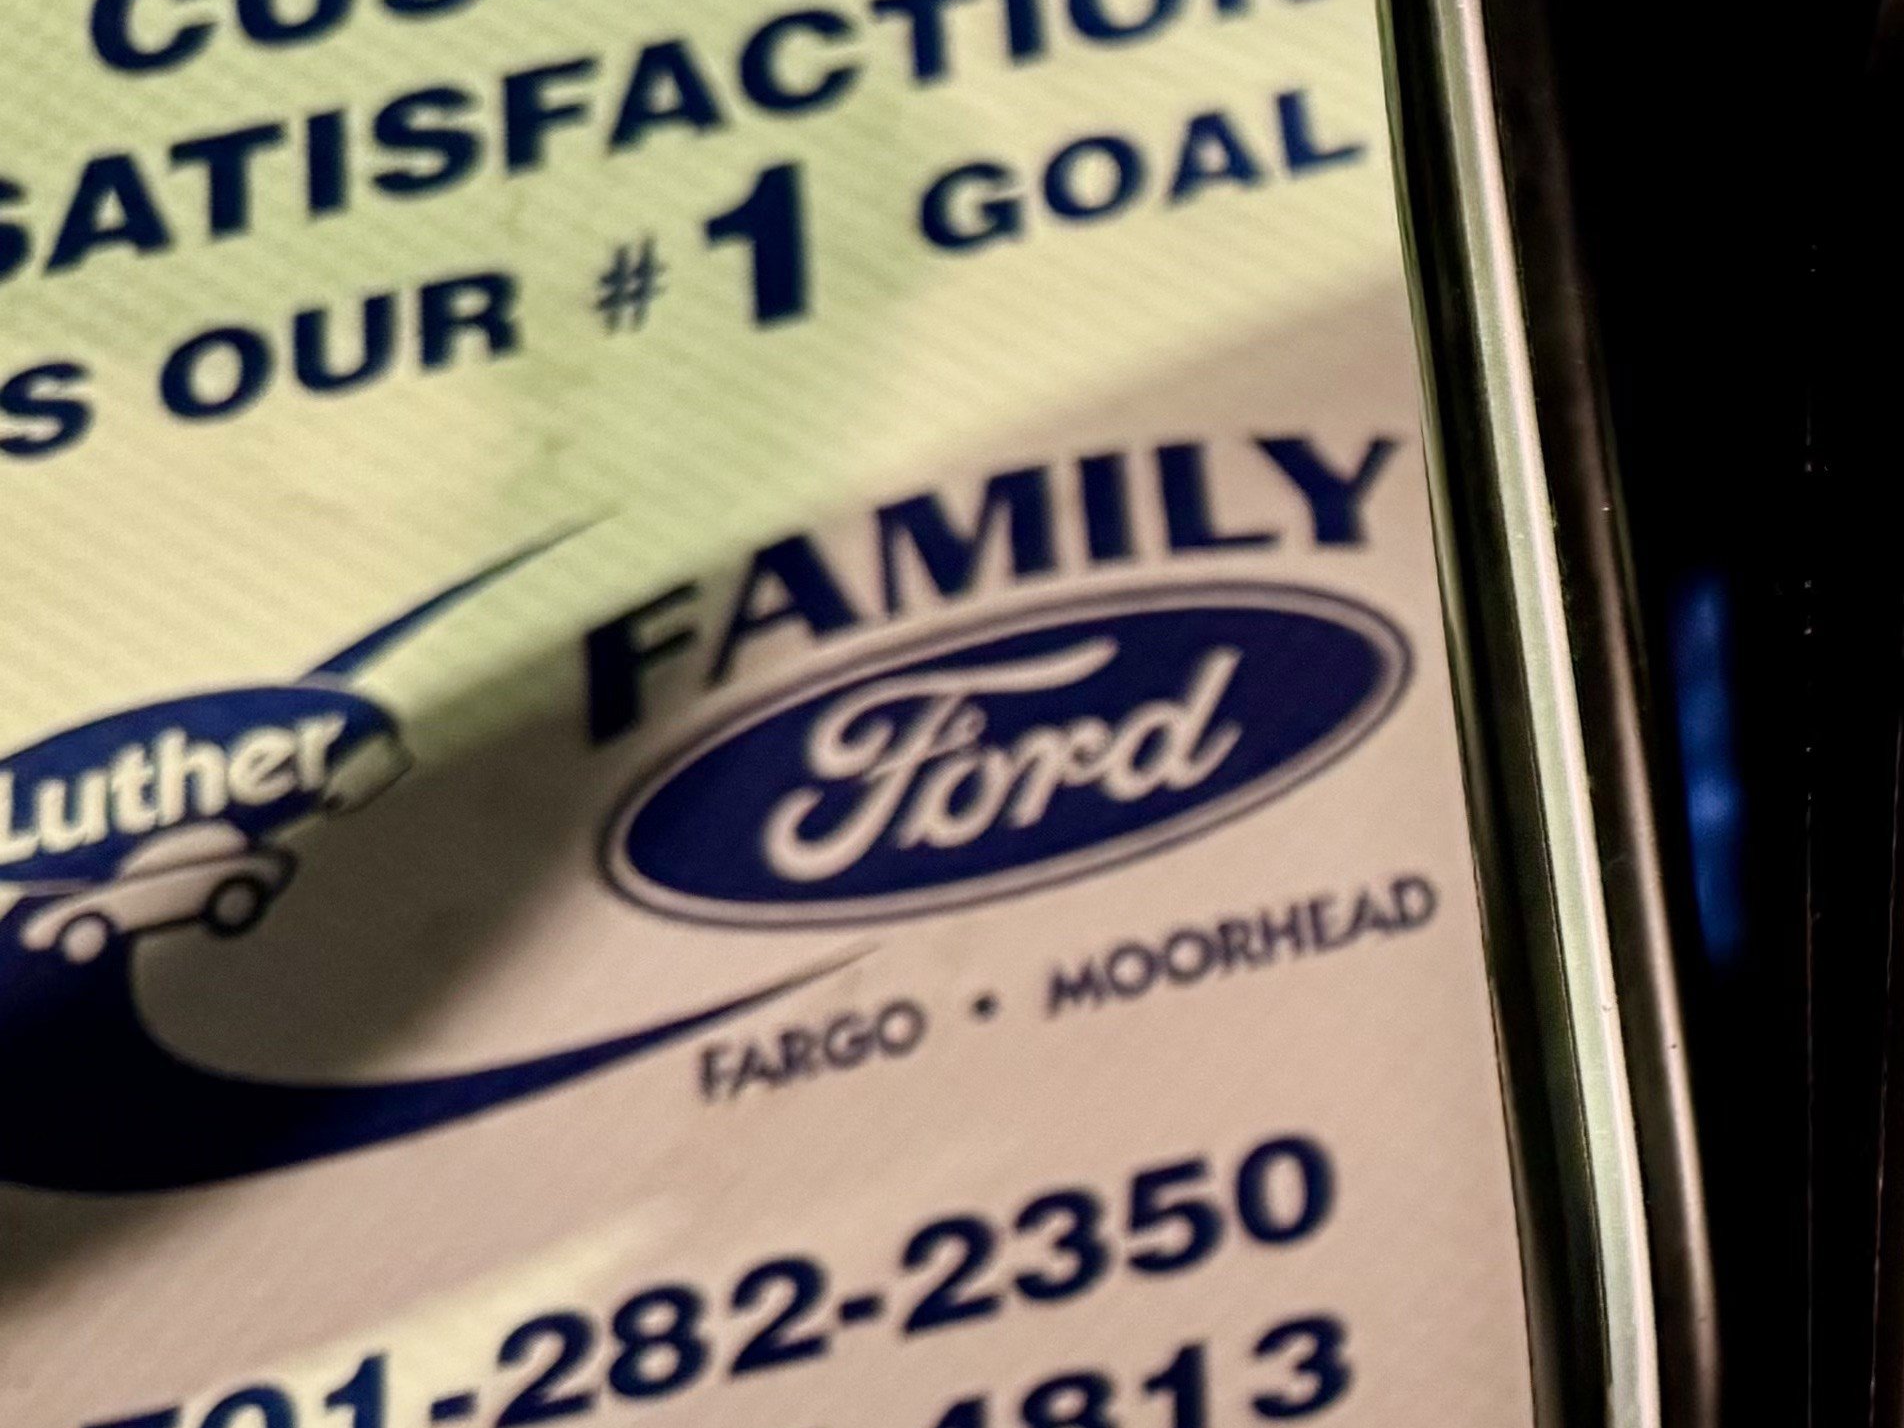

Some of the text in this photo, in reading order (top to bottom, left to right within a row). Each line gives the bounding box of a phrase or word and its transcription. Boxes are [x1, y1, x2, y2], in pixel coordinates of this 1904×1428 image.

[159, 271, 520, 421] OUR
[913, 91, 1362, 255] GOAL
[573, 434, 1399, 763] FAMILY
[765, 641, 1238, 880] Ford
[696, 874, 1439, 1103] FARGO MOORHEAD
